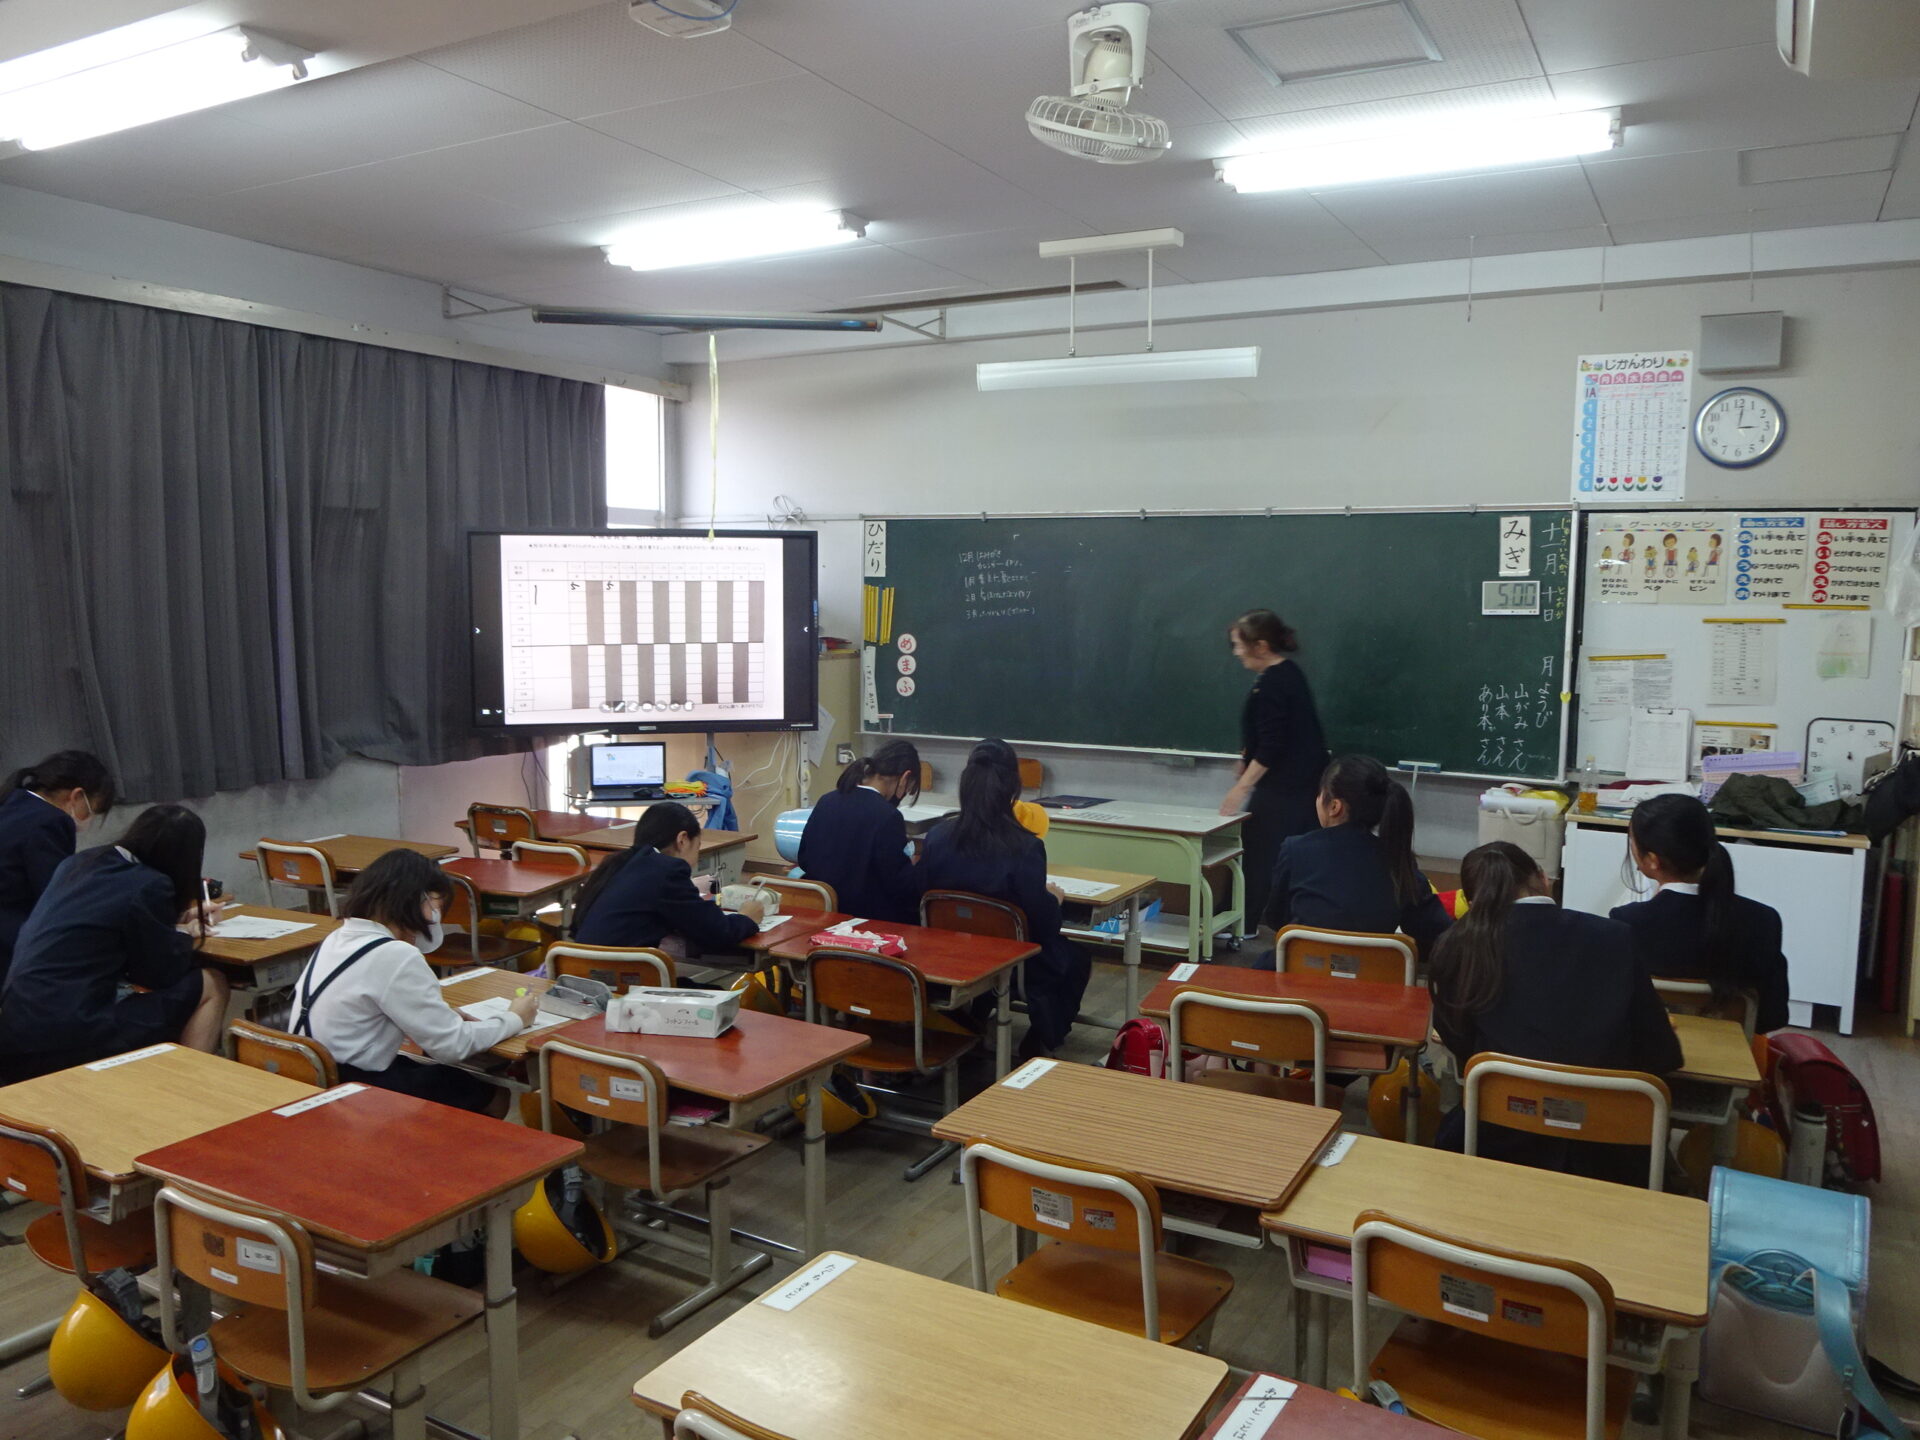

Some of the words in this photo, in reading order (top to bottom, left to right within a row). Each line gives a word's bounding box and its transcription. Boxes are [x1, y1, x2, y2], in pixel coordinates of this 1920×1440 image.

[1605, 357, 1664, 370] じかんわり
[1720, 402, 1729, 412] 11
[1734, 398, 1745, 408] 12
[1751, 400, 1755, 410] 1
[1710, 412, 1720, 422] 10
[1759, 408, 1766, 418] 2
[1707, 425, 1714, 435] 9
[1763, 420, 1770, 431] 3
[1711, 438, 1718, 446] 8
[1759, 434, 1765, 443] 4
[1722, 445, 1728, 455] 7
[1734, 447, 1742, 457] 6
[1748, 443, 1755, 453] 5
[868, 523, 884, 574] ひだり
[1503, 520, 1527, 570] みぎ
[900, 638, 913, 650] め
[902, 658, 912, 672] ま
[899, 680, 912, 693] ふ
